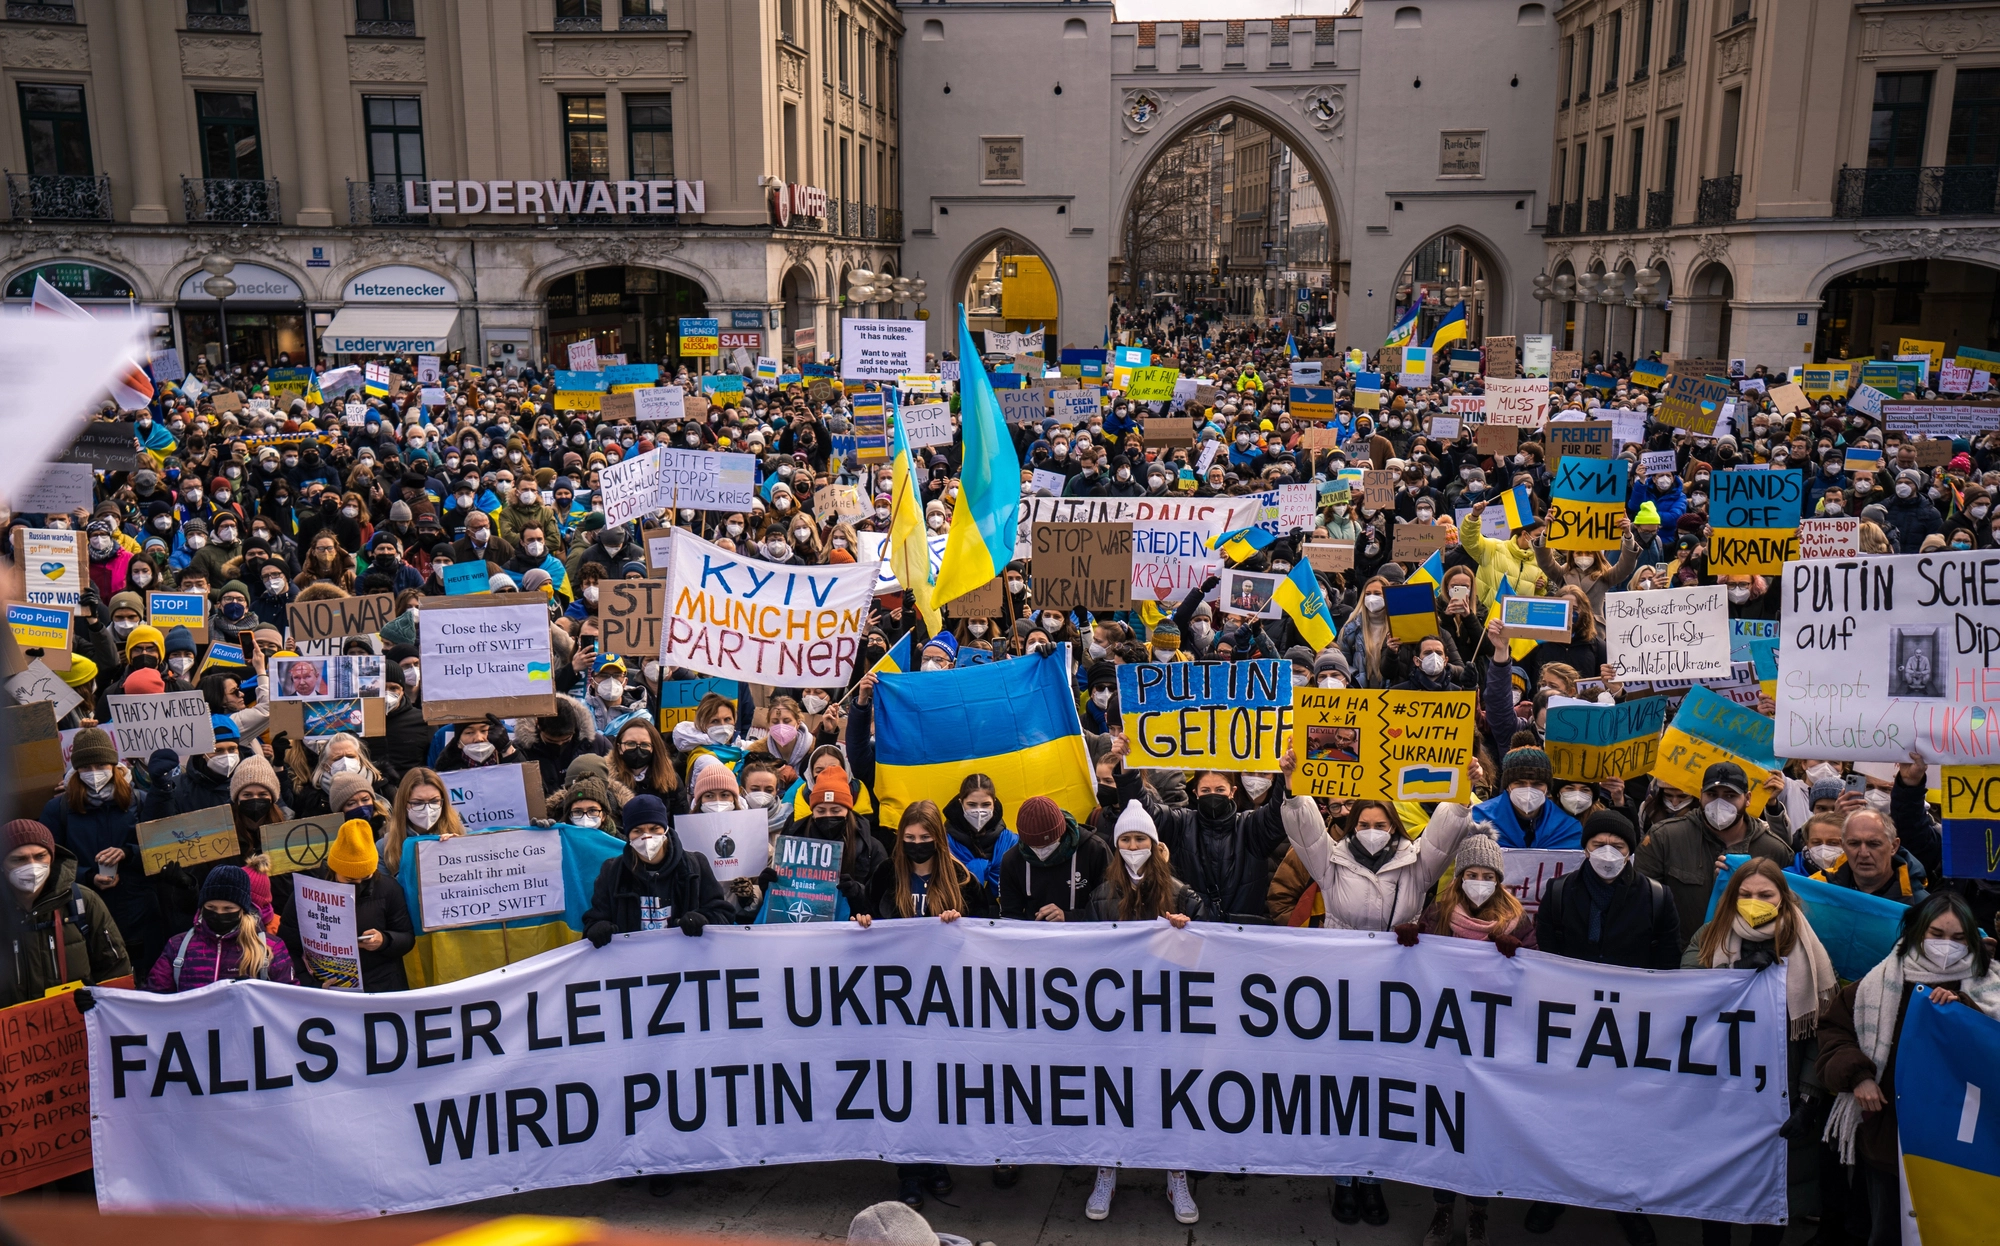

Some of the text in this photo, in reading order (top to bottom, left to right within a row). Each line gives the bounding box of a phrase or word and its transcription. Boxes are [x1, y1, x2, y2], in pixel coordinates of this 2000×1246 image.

[404, 180, 705, 214] LEDERWAREN
[354, 282, 446, 296] Hetzenecker
[1300, 288, 1309, 300] U
[684, 327, 716, 335] EMBARGO
[854, 323, 913, 333] russia is insane.
[721, 334, 758, 346] SALE
[860, 332, 907, 341] It has nukes.
[335, 337, 435, 352] Lederwaren
[683, 343, 717, 351] RUSSLAND
[861, 349, 880, 357] Want
[890, 350, 906, 358] wait
[860, 357, 874, 365] and
[889, 358, 908, 366] what
[856, 366, 911, 377] might happen?
[1133, 370, 1157, 383] IF WE
[274, 381, 306, 390] UKRAINE
[1486, 382, 1549, 394] DEUTSCHLAND
[1678, 378, 1728, 402] STAND
[250, 401, 270, 409] STAND
[568, 399, 595, 409] sky!
[1004, 392, 1040, 403] FUCK
[1066, 397, 1094, 406] LEBEN
[1496, 397, 1535, 412] MUSS
[346, 406, 365, 414] STOP
[1004, 405, 1045, 420] PUTIN
[1073, 405, 1098, 415] SWIFT
[1450, 398, 1486, 413] STOP
[1954, 405, 1969, 413] swift
[905, 407, 943, 424] STOP
[1490, 412, 1532, 425] HELFEN
[1660, 407, 1716, 435] UKRAINE
[1932, 413, 1999, 422] Ungarn Zypern
[1945, 421, 1970, 429] sterben,
[99, 434, 134, 447] warship
[1551, 427, 1611, 443] FREIHEIT
[1345, 443, 1369, 453] NO WAR
[1561, 443, 1602, 455] FÜR DIE
[74, 446, 138, 467] fuck yourself
[1642, 454, 1674, 464] STÜRZT
[661, 469, 719, 488] STOPPT
[1366, 471, 1394, 486] STOP
[820, 487, 846, 501] НЕТ
[1287, 484, 1307, 492] BAN
[1713, 472, 1802, 504] HANDS
[1280, 493, 1313, 503] RUSSIA
[1320, 490, 1349, 504] UKRAINE
[606, 497, 637, 525] STOP
[1284, 505, 1309, 513] FROM
[1280, 513, 1314, 527] SWIFT
[1726, 506, 1782, 528] OFF
[28, 531, 74, 543] Russian warship
[1036, 526, 1132, 556] STOP WAR
[51, 546, 74, 555] yourself
[1071, 555, 1092, 578] IN
[1155, 555, 1178, 565] FÜR
[447, 571, 485, 583] HEUTE WIR
[701, 554, 839, 608] KYIV
[28, 592, 80, 605] STOP WAR
[1033, 577, 1126, 609] UKRAINE!
[153, 599, 188, 610] STOP!
[9, 610, 61, 624] Drop Putin
[153, 615, 202, 624] PUTIN'S WAR
[289, 596, 393, 638] NO WAR
[33, 627, 63, 639] bombs
[441, 620, 521, 636] Close the sky
[1796, 616, 1856, 651] auf
[436, 637, 534, 655] Turn off SWIFT
[444, 660, 525, 678] Help Ukraine
[1785, 669, 1870, 713] Stoppt
[179, 697, 206, 717] NEED
[1301, 694, 1369, 712] ИДИ НА
[1392, 701, 1471, 720] #STAND
[1556, 705, 1628, 741] STOP
[118, 722, 194, 752] DEMOCRACY
[1138, 704, 1228, 758] GET
[1405, 725, 1459, 740] WITH
[1392, 744, 1467, 766] UKRAINE
[1301, 762, 1364, 781] GO TO
[1310, 779, 1361, 798] HELL
[152, 843, 208, 867] PEACE
[438, 845, 546, 866] Das russische Gas
[782, 839, 833, 868] NATO
[724, 858, 739, 866] WAR
[438, 864, 526, 884] bezahlt ihr mit
[774, 864, 837, 882] Help UKRAINE!
[440, 877, 549, 901] ukrainischem Blut
[791, 879, 816, 890] Against
[302, 886, 346, 908] UKRAINE
[771, 887, 834, 902] russian occupation!
[317, 902, 329, 913] hat
[441, 894, 547, 919] #STOP_SWIFT
[307, 909, 341, 925] das Recht
[316, 921, 331, 932] sich
[319, 931, 328, 940] zu
[302, 935, 354, 956] verteidigen!
[111, 964, 1767, 1099] FALLS DER LETZTE UKRAINISCHE SOLDAT FÄLLT,
[414, 1059, 1466, 1167] WIRD PUTIN ZU IHNEN KOMMEN
